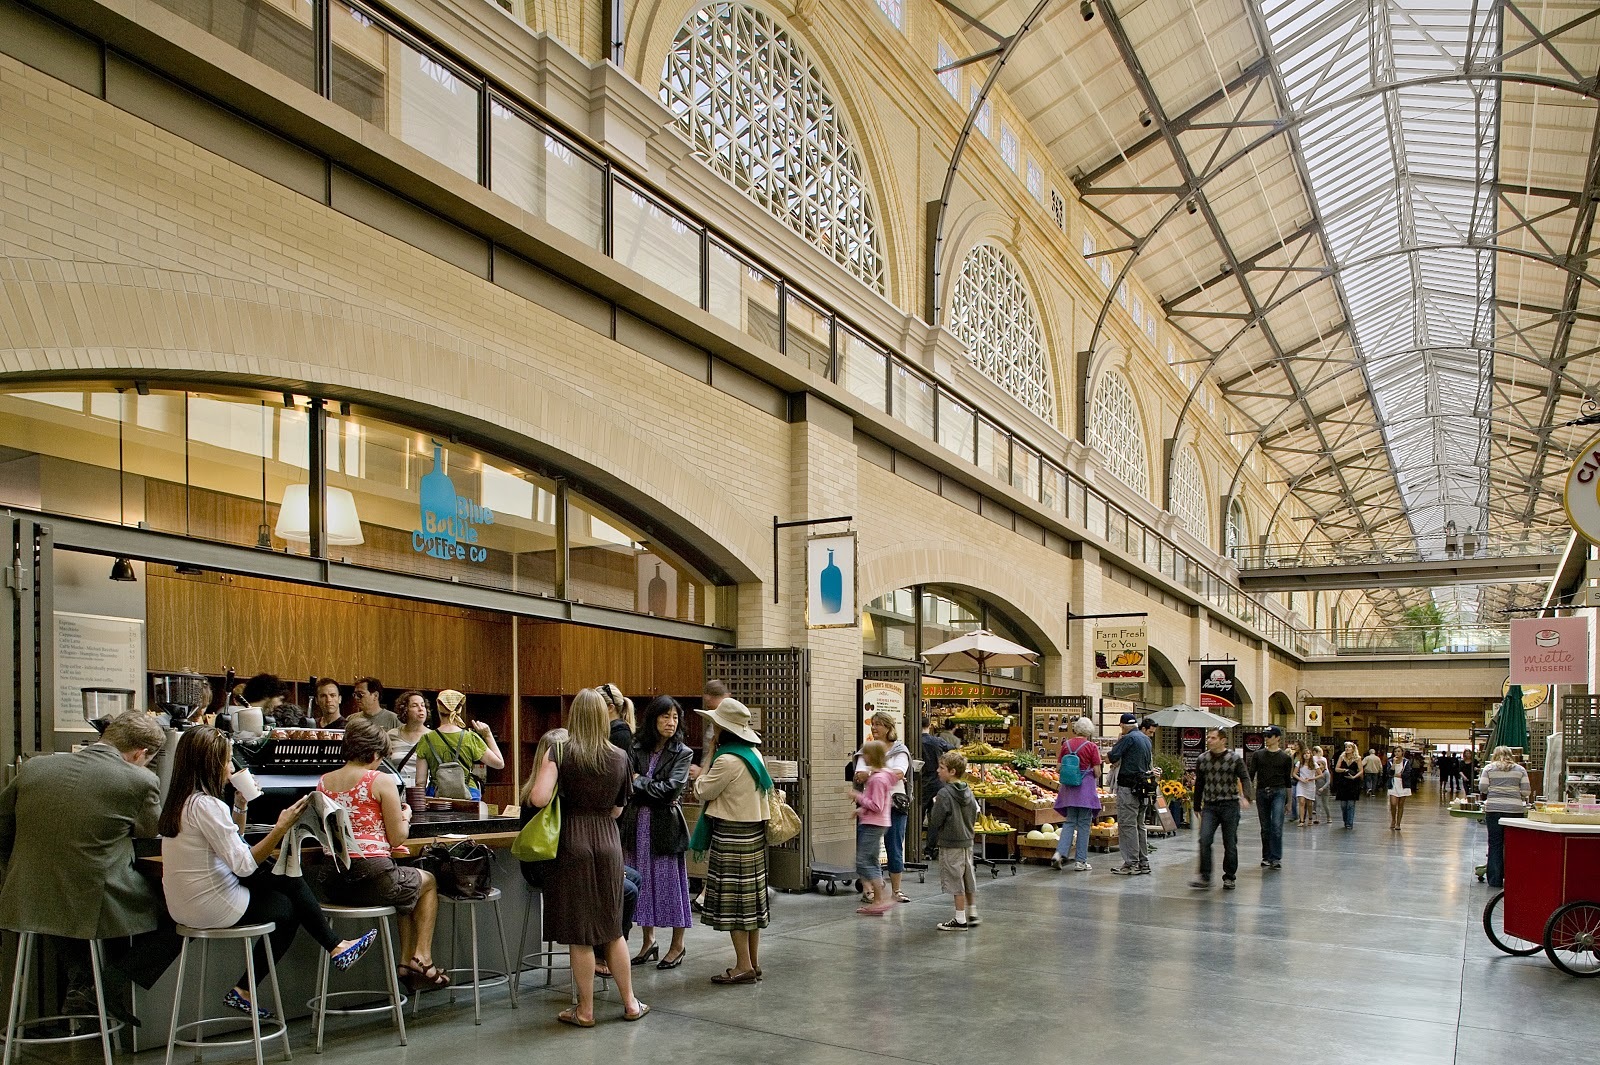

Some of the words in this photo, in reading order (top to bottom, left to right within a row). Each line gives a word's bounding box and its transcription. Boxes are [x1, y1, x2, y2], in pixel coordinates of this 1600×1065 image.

[456, 496, 494, 525] Blue
[425, 510, 478, 543] Bottle
[1096, 631, 1118, 639] Farm
[1120, 629, 1144, 638] Fresh
[1104, 640, 1116, 649] To
[1119, 640, 1136, 648] You
[1524, 650, 1574, 664] miette
[924, 687, 963, 695] SNACKS
